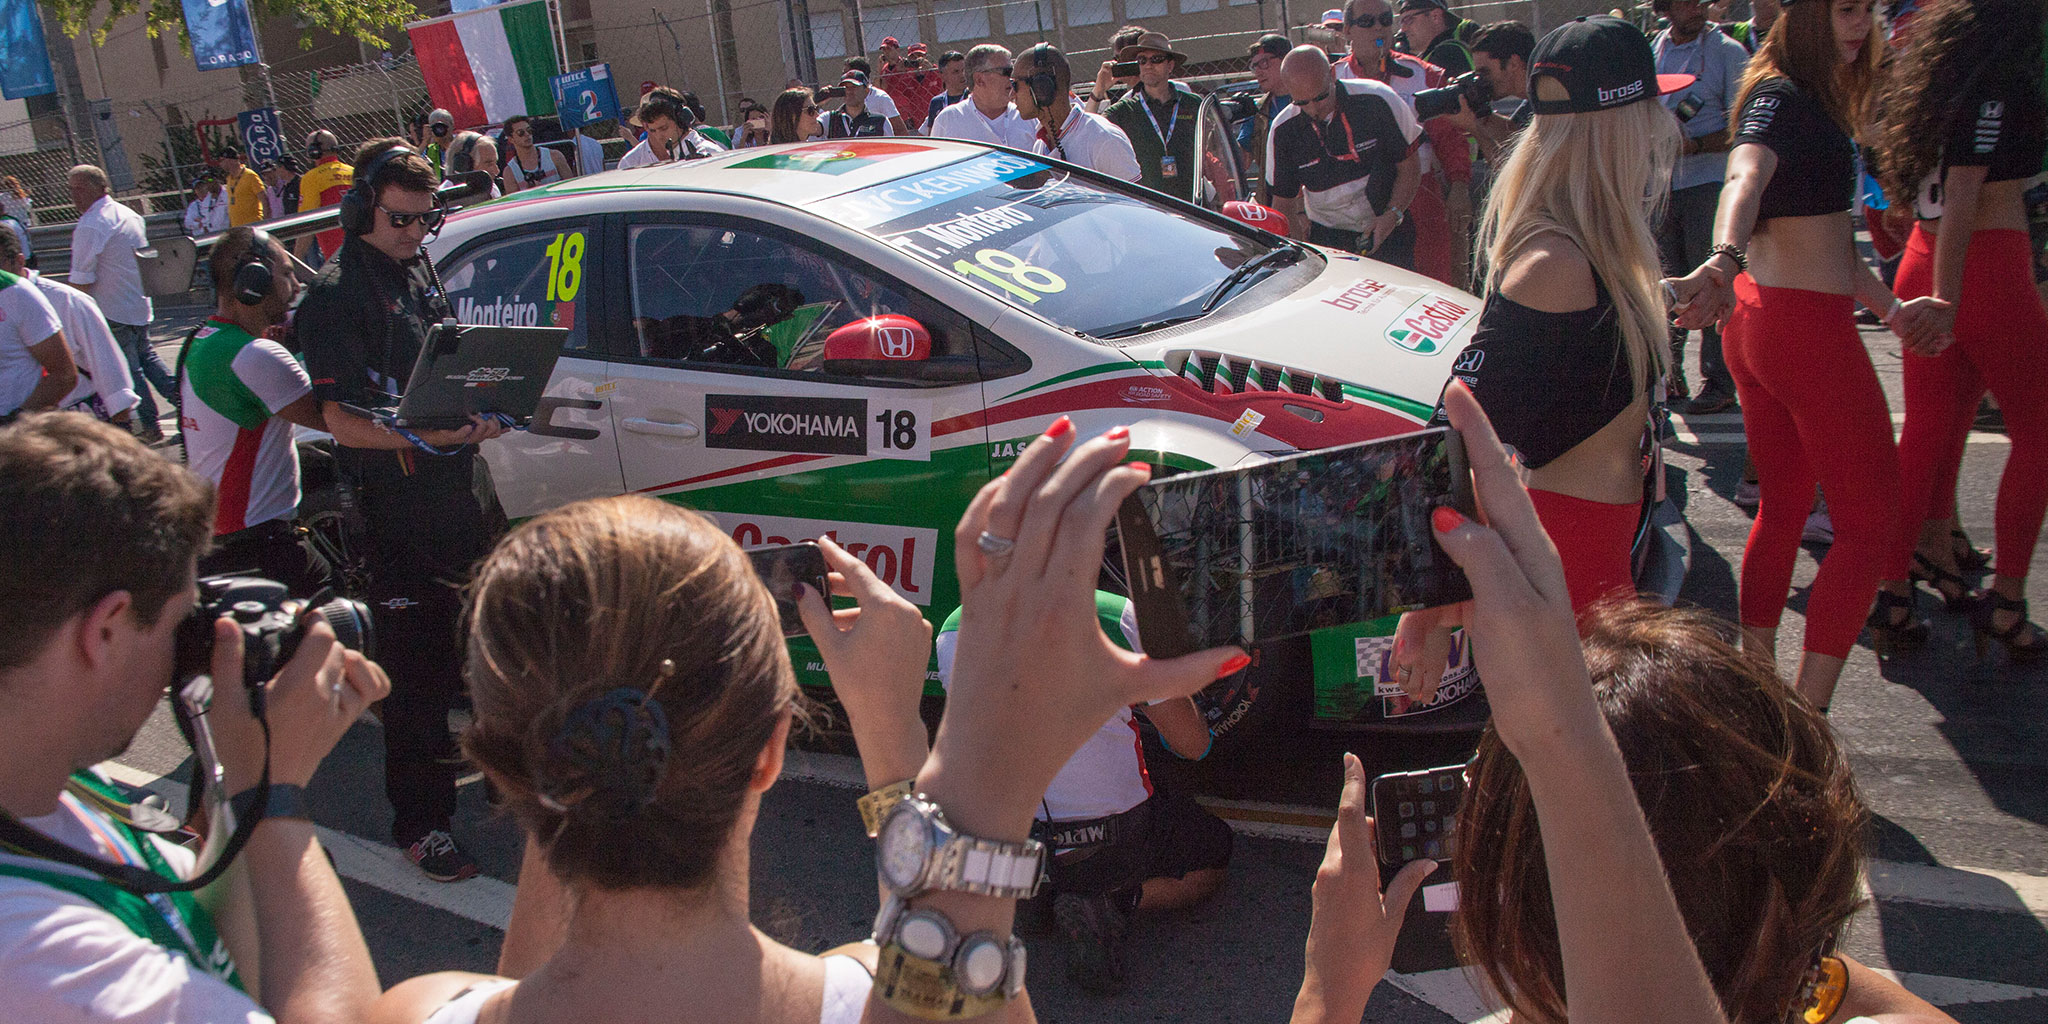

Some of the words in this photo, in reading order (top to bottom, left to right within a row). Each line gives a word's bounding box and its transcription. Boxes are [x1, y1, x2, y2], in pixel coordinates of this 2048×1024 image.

[579, 90, 603, 122] 2
[1597, 79, 1644, 101] brose
[916, 205, 1034, 250] Monteiro
[546, 232, 585, 302] 18
[953, 248, 1067, 304] 18
[458, 295, 538, 327] Monteiro
[1320, 278, 1387, 311] brose
[1404, 296, 1471, 340] Castrol
[744, 412, 859, 438] YOKOHAMA
[876, 409, 917, 450] 18
[1213, 699, 1252, 737] YOKOHAM
